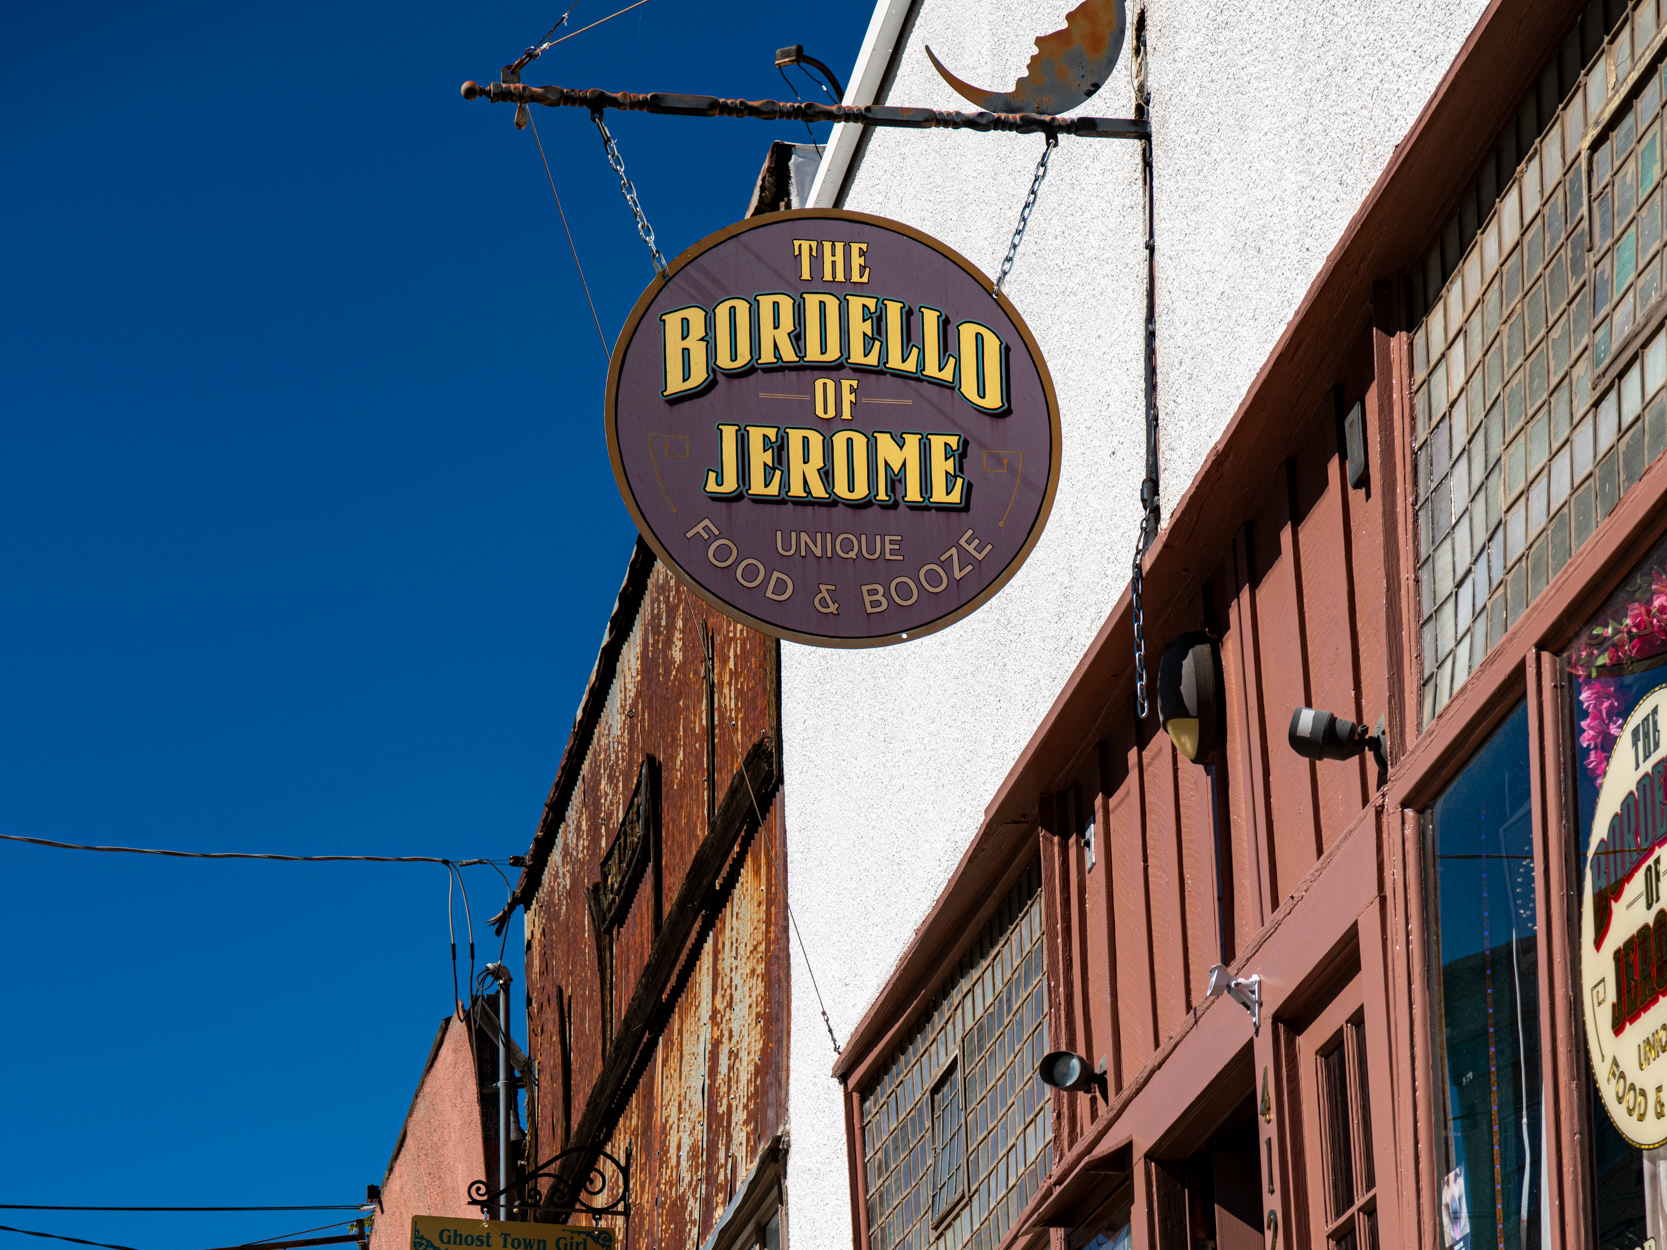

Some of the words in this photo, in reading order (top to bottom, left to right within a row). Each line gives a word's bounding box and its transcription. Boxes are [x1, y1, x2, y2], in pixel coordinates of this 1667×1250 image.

[793, 239, 870, 283] THE
[659, 291, 1010, 415] BORDELLO
[813, 378, 859, 420] OF
[703, 423, 967, 510] JEROME
[685, 517, 795, 602] FOOD
[813, 584, 840, 615] &
[861, 528, 993, 615] BOOZE
[775, 530, 905, 561] UNIQUE
[631, 704, 661, 772] THE
[1643, 855, 1661, 911] OF
[1607, 1055, 1648, 1122] FOOD
[438, 1228, 493, 1248] Ghost
[500, 1232, 547, 1250] Town
